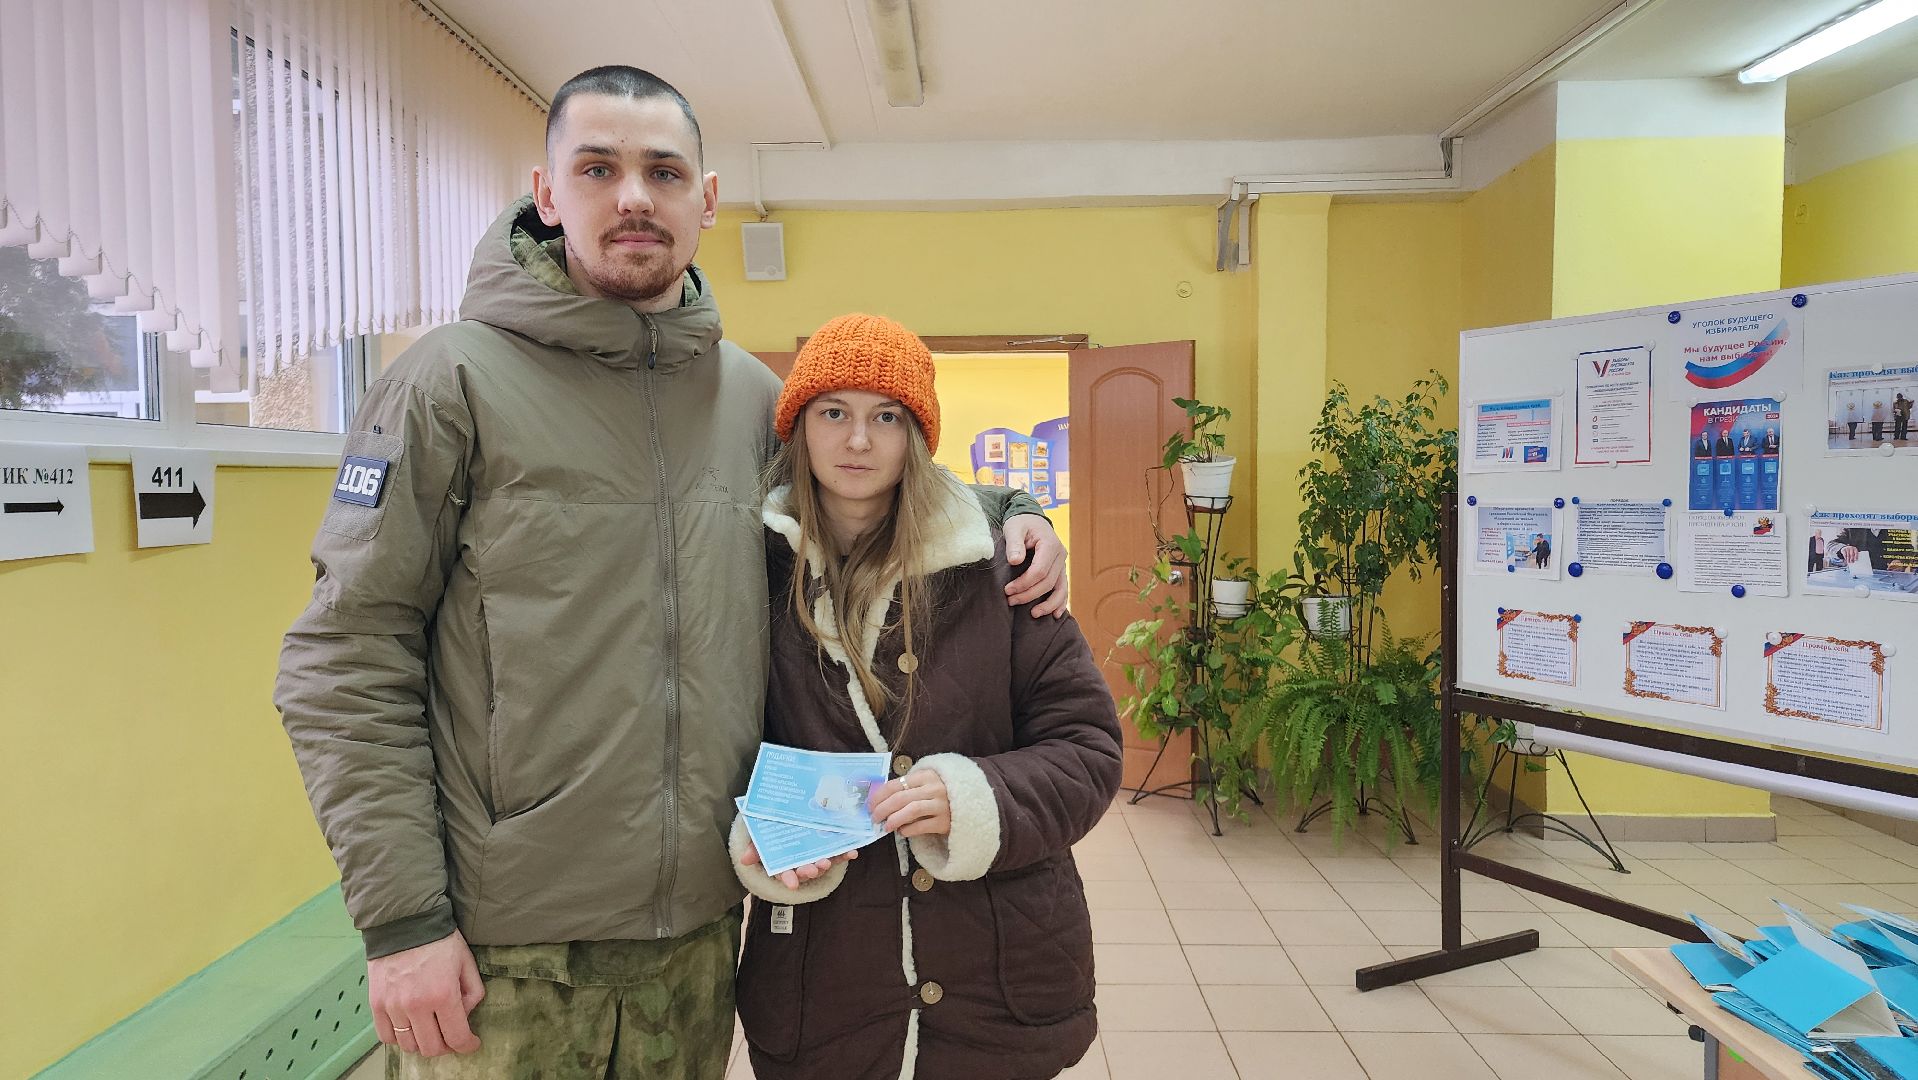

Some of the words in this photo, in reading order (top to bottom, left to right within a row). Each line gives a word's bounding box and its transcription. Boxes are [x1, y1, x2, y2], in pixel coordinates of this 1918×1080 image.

[1692, 319, 1725, 329] УГОЛОК
[1727, 313, 1774, 325] БУДУЩЕГО
[1705, 323, 1760, 335] ИЗБИРАТЕЛЯ
[1684, 346, 1700, 354] Мы
[1702, 342, 1745, 353] будущее
[1699, 355, 1718, 363] нам
[1852, 368, 1898, 379] продят
[1703, 403, 1773, 417] КАНДИДАТЫ
[0, 467, 29, 485] ИК
[33, 468, 74, 485] №412
[151, 466, 183, 488] 411
[337, 463, 382, 497] 106
[1832, 512, 1876, 520] проходят
[1801, 641, 1832, 653] Проверь
[1833, 645, 1849, 653] себя
